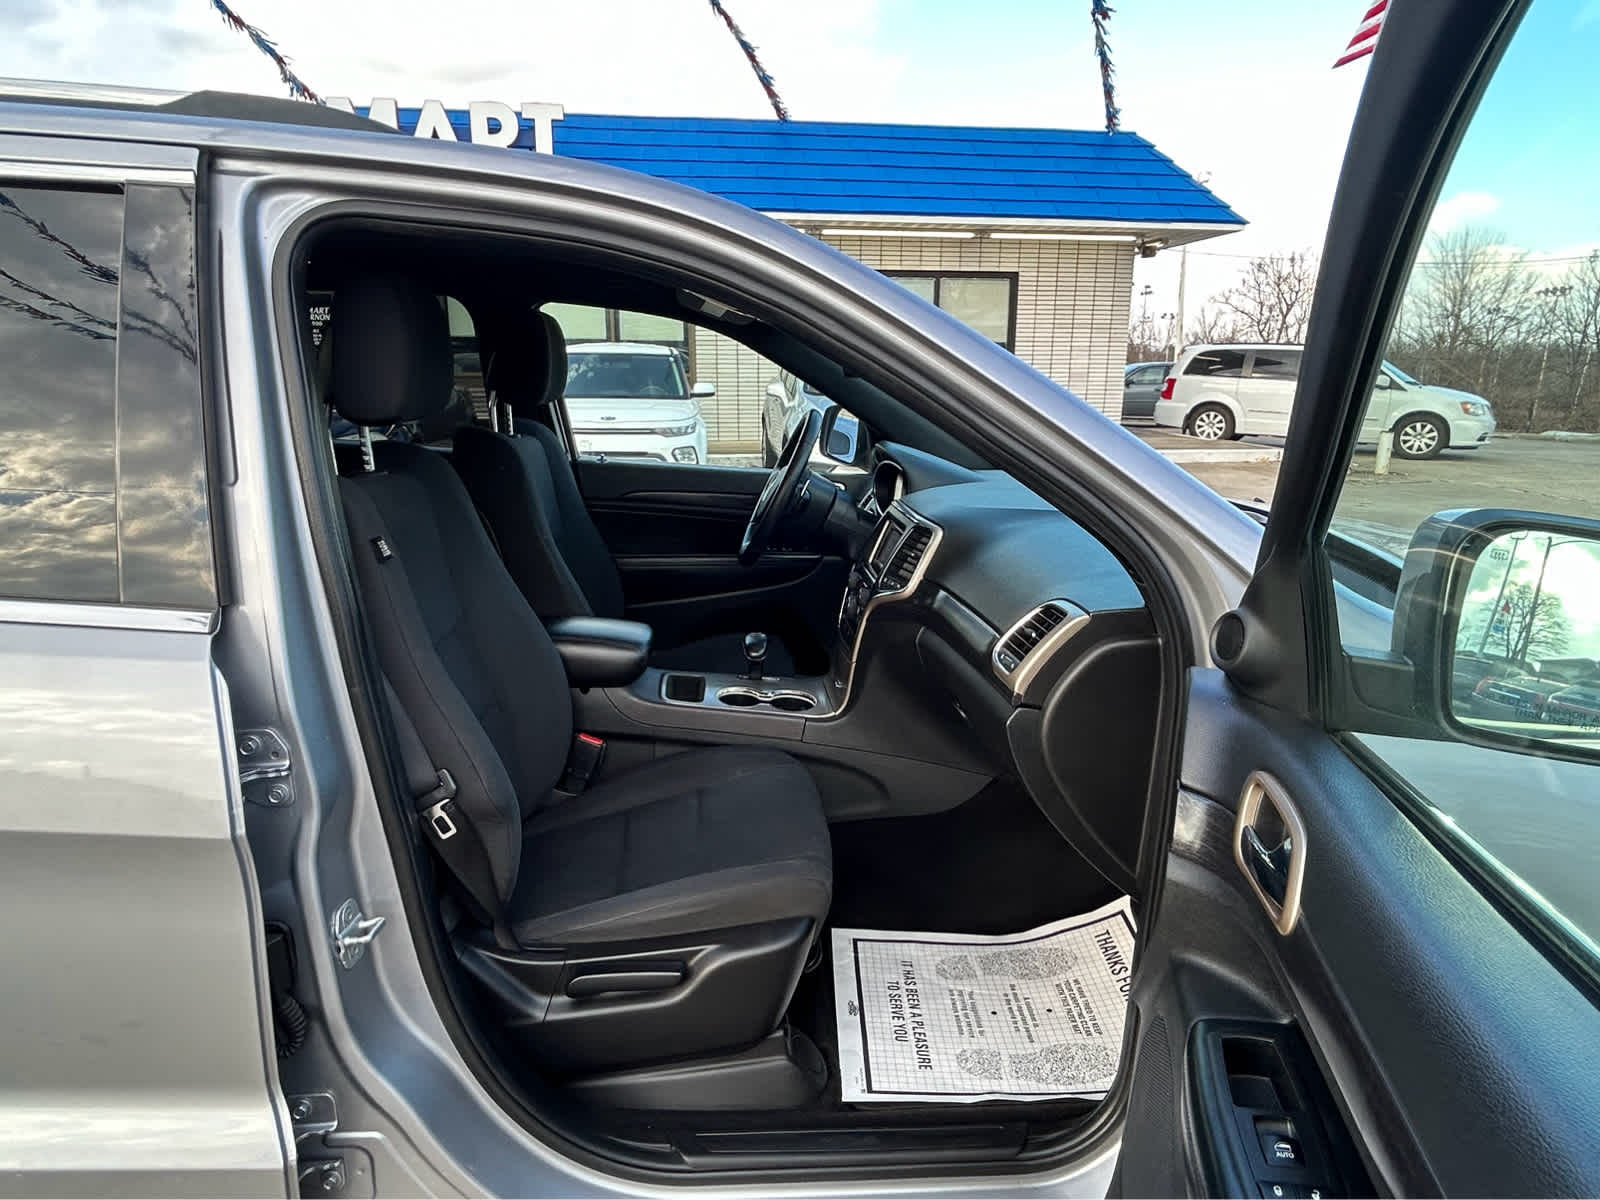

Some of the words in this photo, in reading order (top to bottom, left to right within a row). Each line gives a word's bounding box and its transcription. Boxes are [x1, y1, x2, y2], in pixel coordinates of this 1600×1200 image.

[1094, 929, 1128, 976] THANKS
[901, 960, 913, 968] IT
[888, 980, 900, 990] TO
[903, 970, 917, 985] HAS
[888, 993, 905, 1020] SERVE
[905, 988, 921, 1009] BEEN
[893, 1023, 909, 1042] YOU
[911, 1020, 933, 1070] PLEASURE
[1275, 1151, 1295, 1159] AUTO
